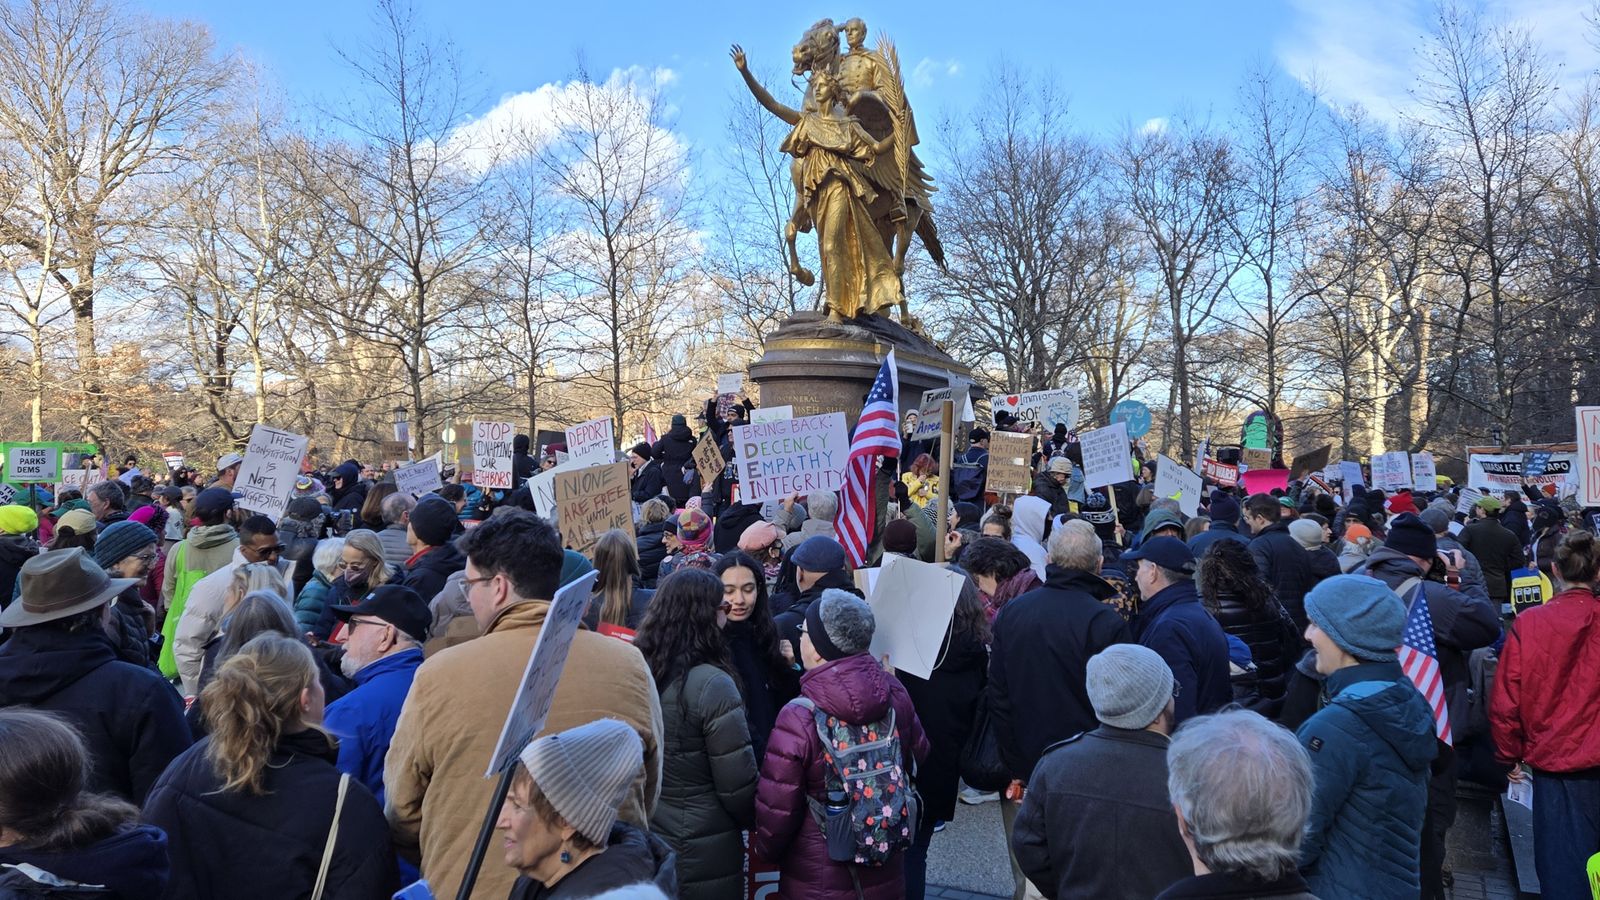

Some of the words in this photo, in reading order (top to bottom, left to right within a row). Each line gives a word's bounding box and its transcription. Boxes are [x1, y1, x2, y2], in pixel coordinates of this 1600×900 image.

[992, 397, 1005, 407] We
[478, 422, 511, 441] STOP
[568, 418, 610, 448] DEPORT
[742, 421, 787, 440] BRING
[790, 415, 833, 433] BACK:
[261, 429, 295, 449] THE
[743, 432, 828, 459] DECENCY
[250, 443, 301, 464] CONSTITUTION
[481, 457, 497, 470] OUR
[17, 466, 40, 474] DEMS
[266, 462, 276, 472] IS
[746, 450, 833, 479] EMPATHY
[248, 466, 273, 487] NOT
[749, 468, 844, 500] INTEGRITY
[235, 486, 290, 511] SUGGESTION
[564, 498, 590, 524] ARE
[593, 485, 627, 512] FREE
[586, 506, 612, 524] UNTIL
[610, 512, 628, 528] ARE
